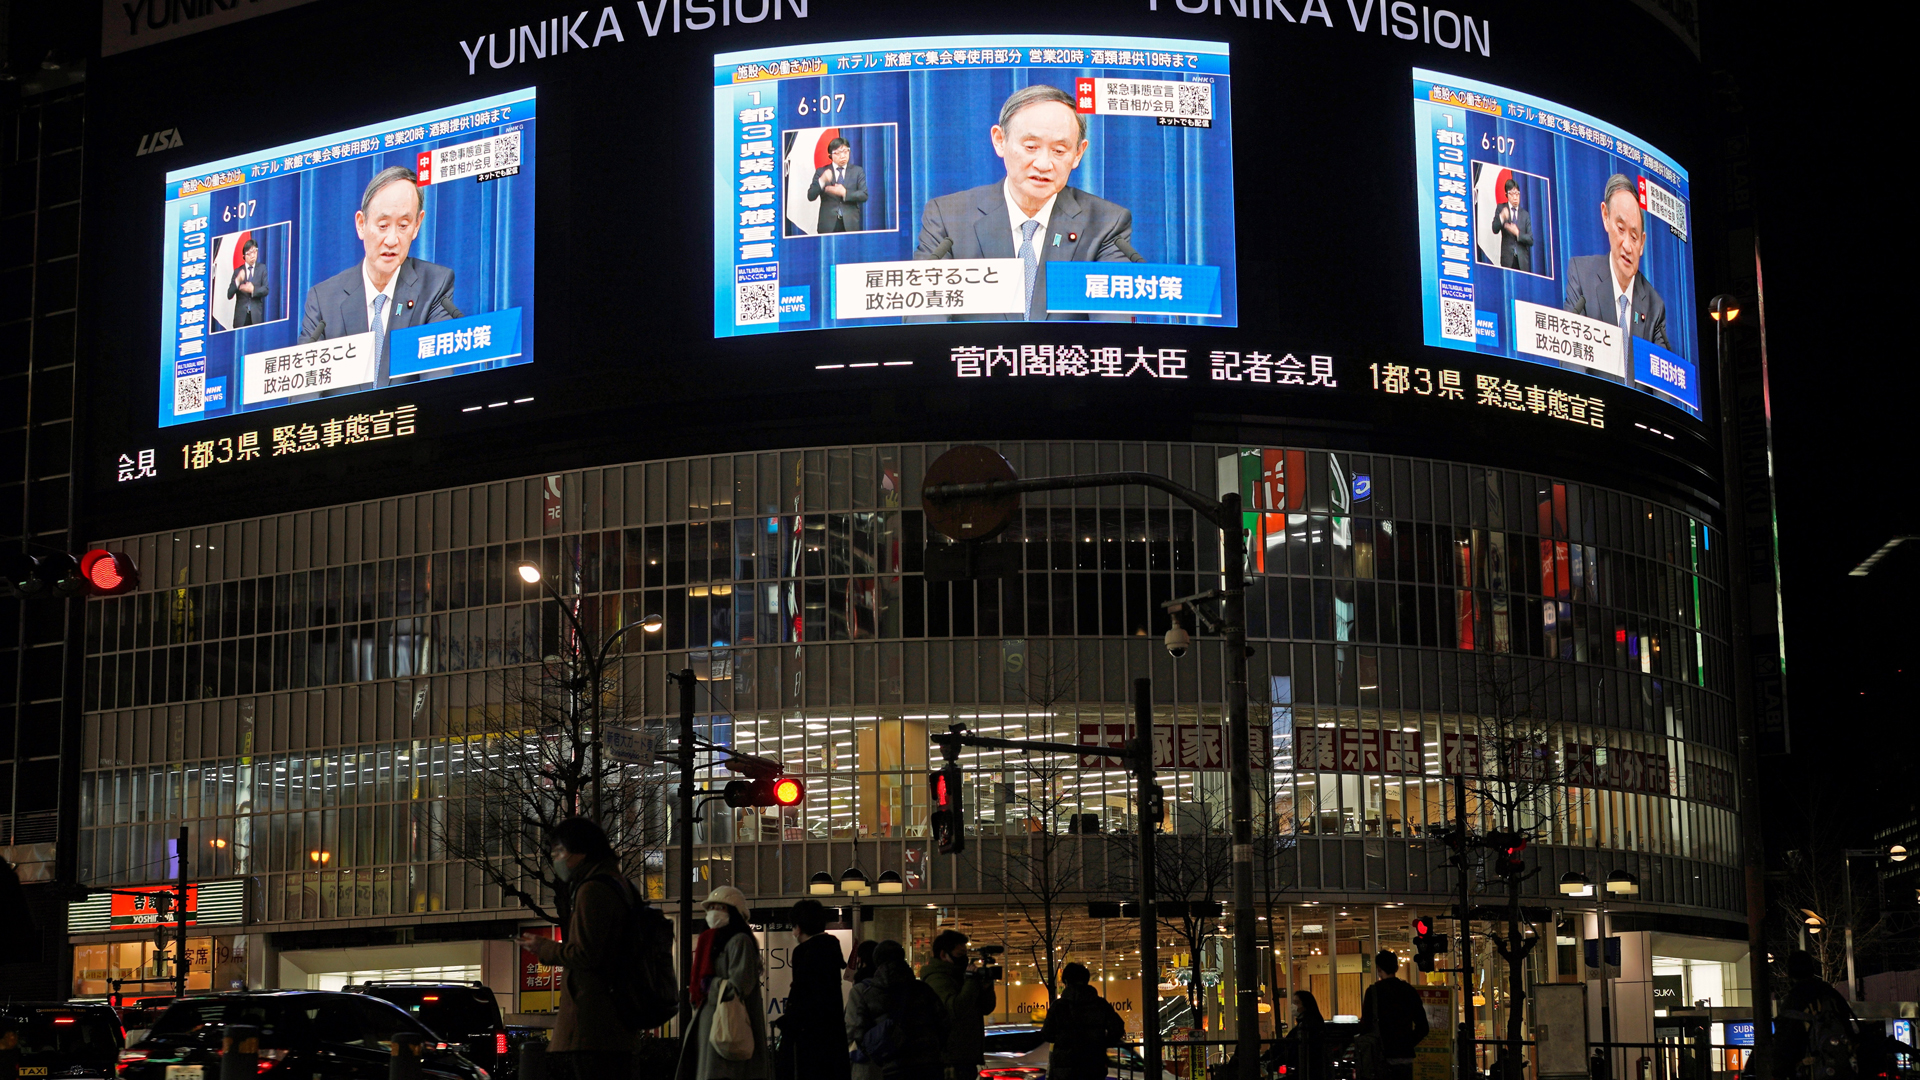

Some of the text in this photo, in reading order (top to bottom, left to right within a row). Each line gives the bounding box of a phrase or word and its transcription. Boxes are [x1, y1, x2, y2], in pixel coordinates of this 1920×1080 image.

[122, 0, 258, 35] YUNI
[1148, 0, 1491, 58] IKA VISION
[459, 0, 809, 76] YUNIKA VISION
[737, 58, 822, 80] 施設への働きかけ
[837, 48, 1199, 71] ホテル・旅館で集会等使用部分 営業20時・酒類提供19時まで
[1079, 82, 1093, 109] 中継
[1106, 82, 1175, 98] 緊急事態宣言
[1432, 85, 1498, 111] 施設への働きかけ
[797, 93, 846, 116] 6:07
[1107, 98, 1175, 113] 菅首相が会見
[1158, 117, 1209, 127] ネットでも配信
[135, 126, 184, 157] LISA
[251, 106, 512, 178] ホテル・旅館で集会等使用部分 営業20時・酒類提供19時まで
[440, 141, 491, 164] 緊急事態宣言
[1481, 132, 1516, 156] 6:07
[419, 156, 430, 182] 中継
[440, 156, 491, 178] 菅首相が会見
[478, 166, 519, 182] ネットでも配信
[738, 91, 776, 260] 1都3県緊急事態宣言
[182, 168, 242, 194] 施設への働きかけ
[222, 199, 257, 223] 6:07
[865, 266, 999, 288] 雇用を守ること
[1084, 274, 1183, 300] 雇用対策
[779, 303, 806, 313] NEWS
[781, 295, 804, 303] NHK
[865, 288, 964, 311] 政治の責務
[1475, 327, 1496, 338] NEWS
[1476, 320, 1494, 329] NHK
[1534, 311, 1612, 347] 雇用を守ること
[417, 324, 492, 360] 雇用対策
[1535, 333, 1595, 363] 政治の責務
[263, 342, 358, 374] 雇用を守ること
[950, 345, 1338, 388] 菅内閣総理大臣 記者会見
[263, 368, 332, 395] 政治の責務
[1649, 353, 1687, 390] 雇用対策
[204, 393, 223, 403] NEWS
[206, 385, 222, 394] NHK
[1368, 361, 1606, 429] 1都3県 緊急事態宣言
[117, 448, 157, 482] 会見
[271, 404, 418, 457] 緊急事態宣言
[1763, 680, 1783, 733] LABI
[1298, 729, 1421, 772] 展示品
[132, 914, 174, 924] YOSHIYA
[1653, 988, 1676, 998] SUKA
